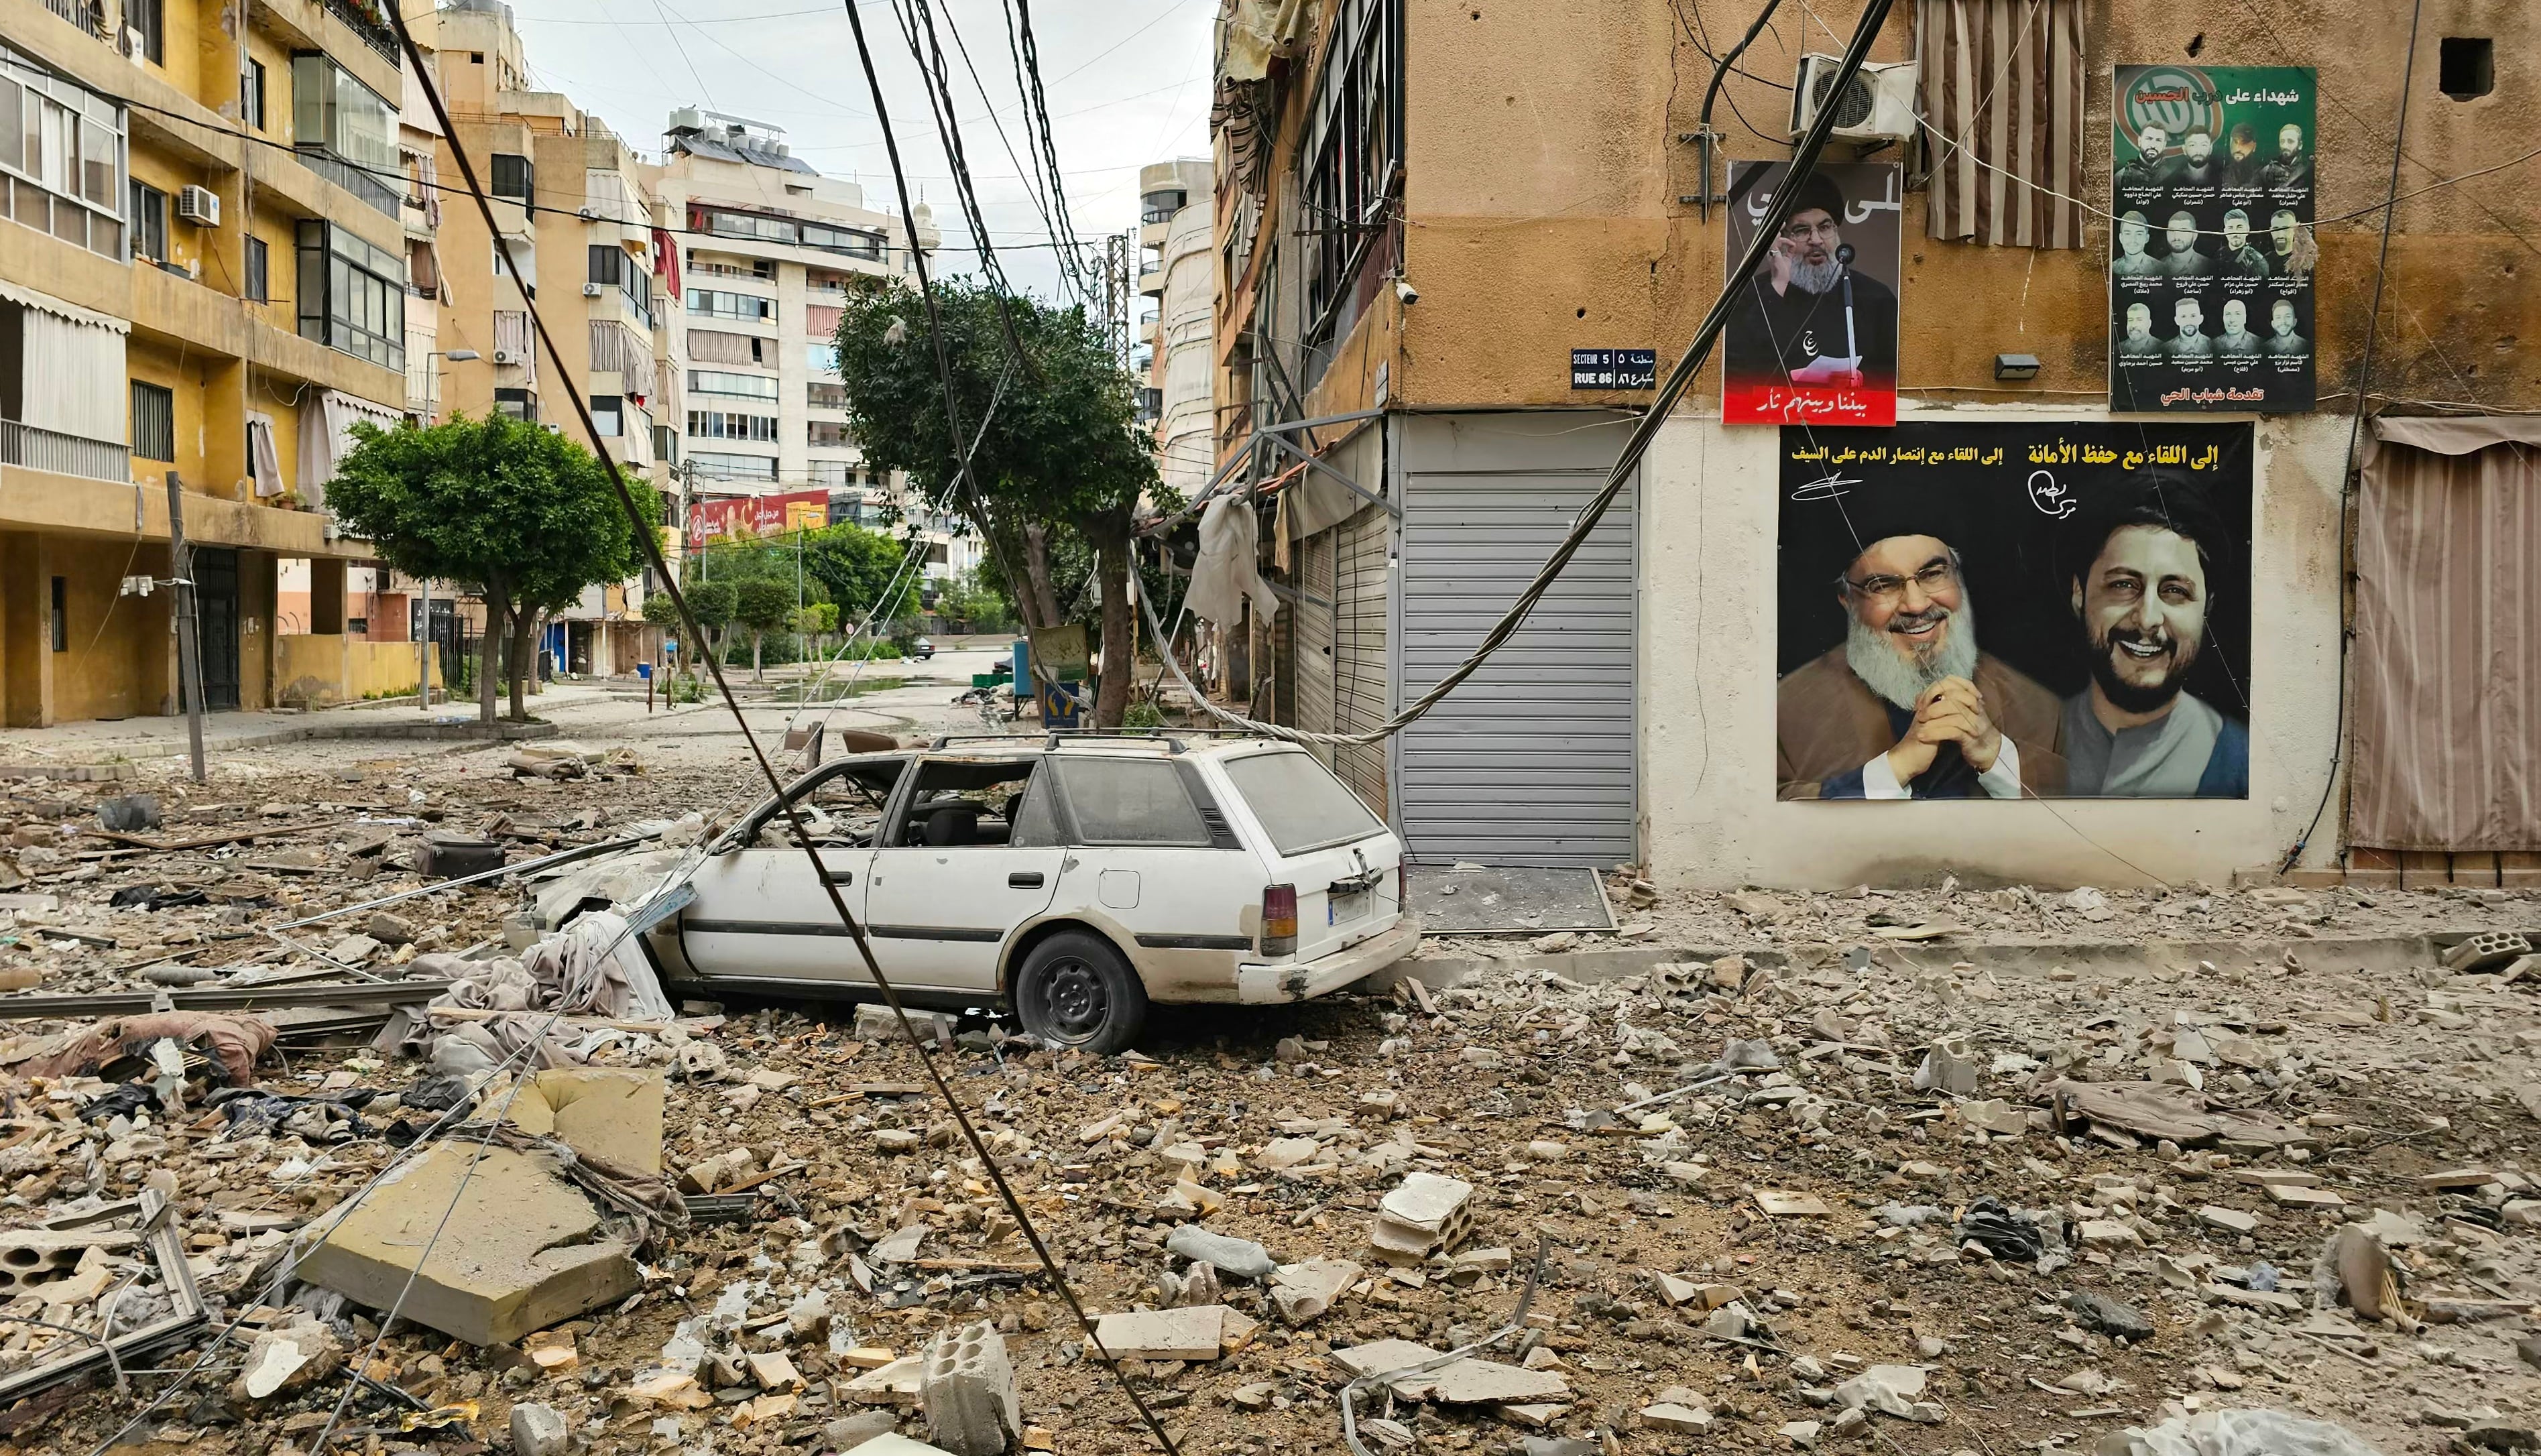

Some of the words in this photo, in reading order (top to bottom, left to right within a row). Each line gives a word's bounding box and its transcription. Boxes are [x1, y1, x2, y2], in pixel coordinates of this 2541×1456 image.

[2135, 86, 2188, 105] الحسين
[2192, 90, 2223, 105] درب
[2225, 88, 2251, 105] على
[2253, 88, 2299, 106] شهداء
[1573, 354, 1598, 365] SECTEUR
[1602, 355, 1609, 364] 5
[1618, 353, 1625, 363] ٥
[1631, 353, 1653, 364] منطقة
[1574, 373, 1596, 383] RUE
[1598, 373, 1612, 383] 86
[1618, 373, 1629, 384] ٨٦
[1631, 373, 1654, 385] شارع
[2161, 387, 2190, 406] الحي
[2192, 387, 2225, 404] شباب
[2227, 387, 2264, 401] تقدمة
[1838, 391, 1867, 417] بيننا
[1791, 446, 1828, 463] السيف
[1832, 447, 1856, 464] على
[1859, 447, 1887, 465] الدم
[1889, 447, 1925, 465] إنتصار
[1928, 450, 1944, 465] مع
[1948, 447, 1978, 461] اللقاء
[1981, 447, 2003, 465] إلى
[2027, 437, 2076, 463] الأمانة
[2081, 444, 2118, 463] حفظ
[2147, 444, 2186, 464] اللقاء
[2190, 444, 2219, 471] إلى
[2122, 449, 2143, 470] مع
